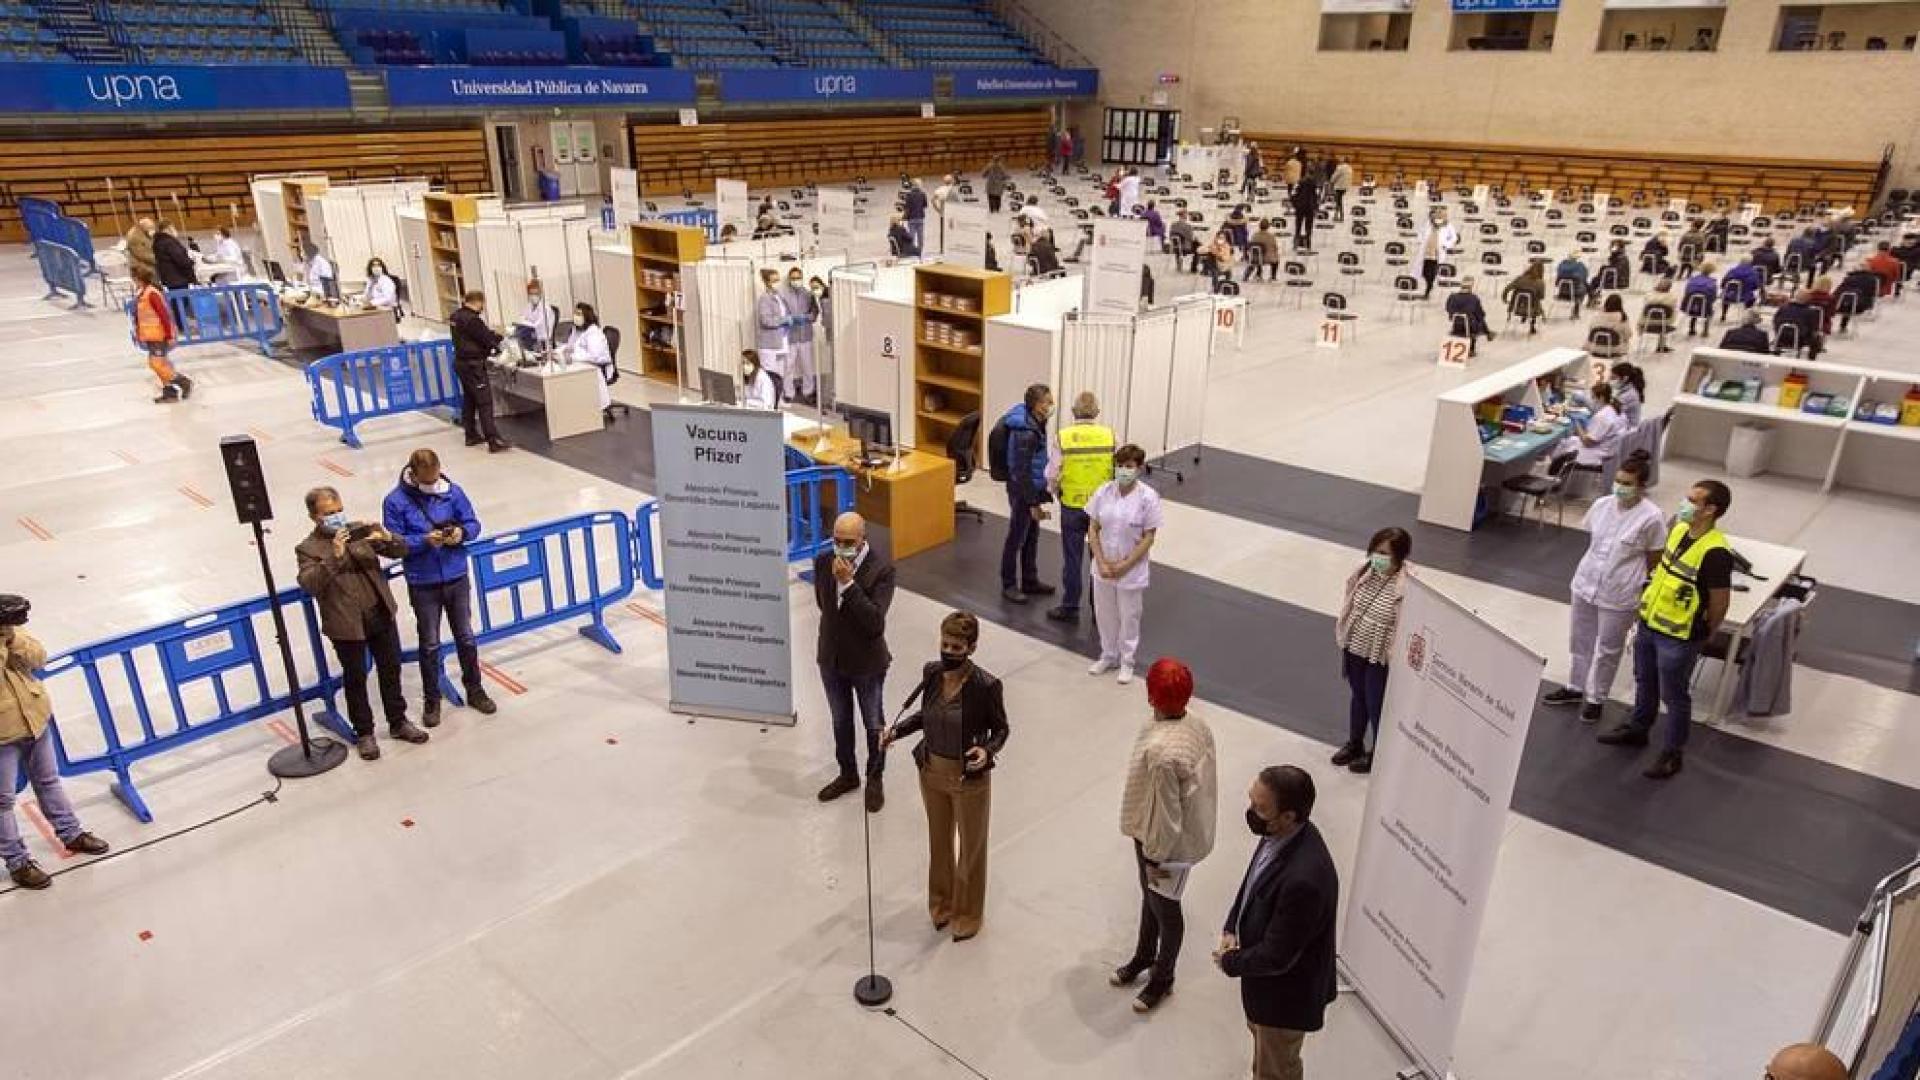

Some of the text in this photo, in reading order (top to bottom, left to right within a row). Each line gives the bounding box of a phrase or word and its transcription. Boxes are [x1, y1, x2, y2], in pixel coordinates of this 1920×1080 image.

[86, 74, 182, 107] upna
[450, 78, 649, 95] Universidad Pública de Navarra
[814, 74, 856, 98] upna
[1216, 309, 1235, 327] 10
[1321, 323, 1338, 342] 11
[883, 336, 893, 354] 8
[1442, 341, 1467, 364] 12
[685, 423, 748, 443] Vacuna
[694, 446, 743, 464] Pfizer
